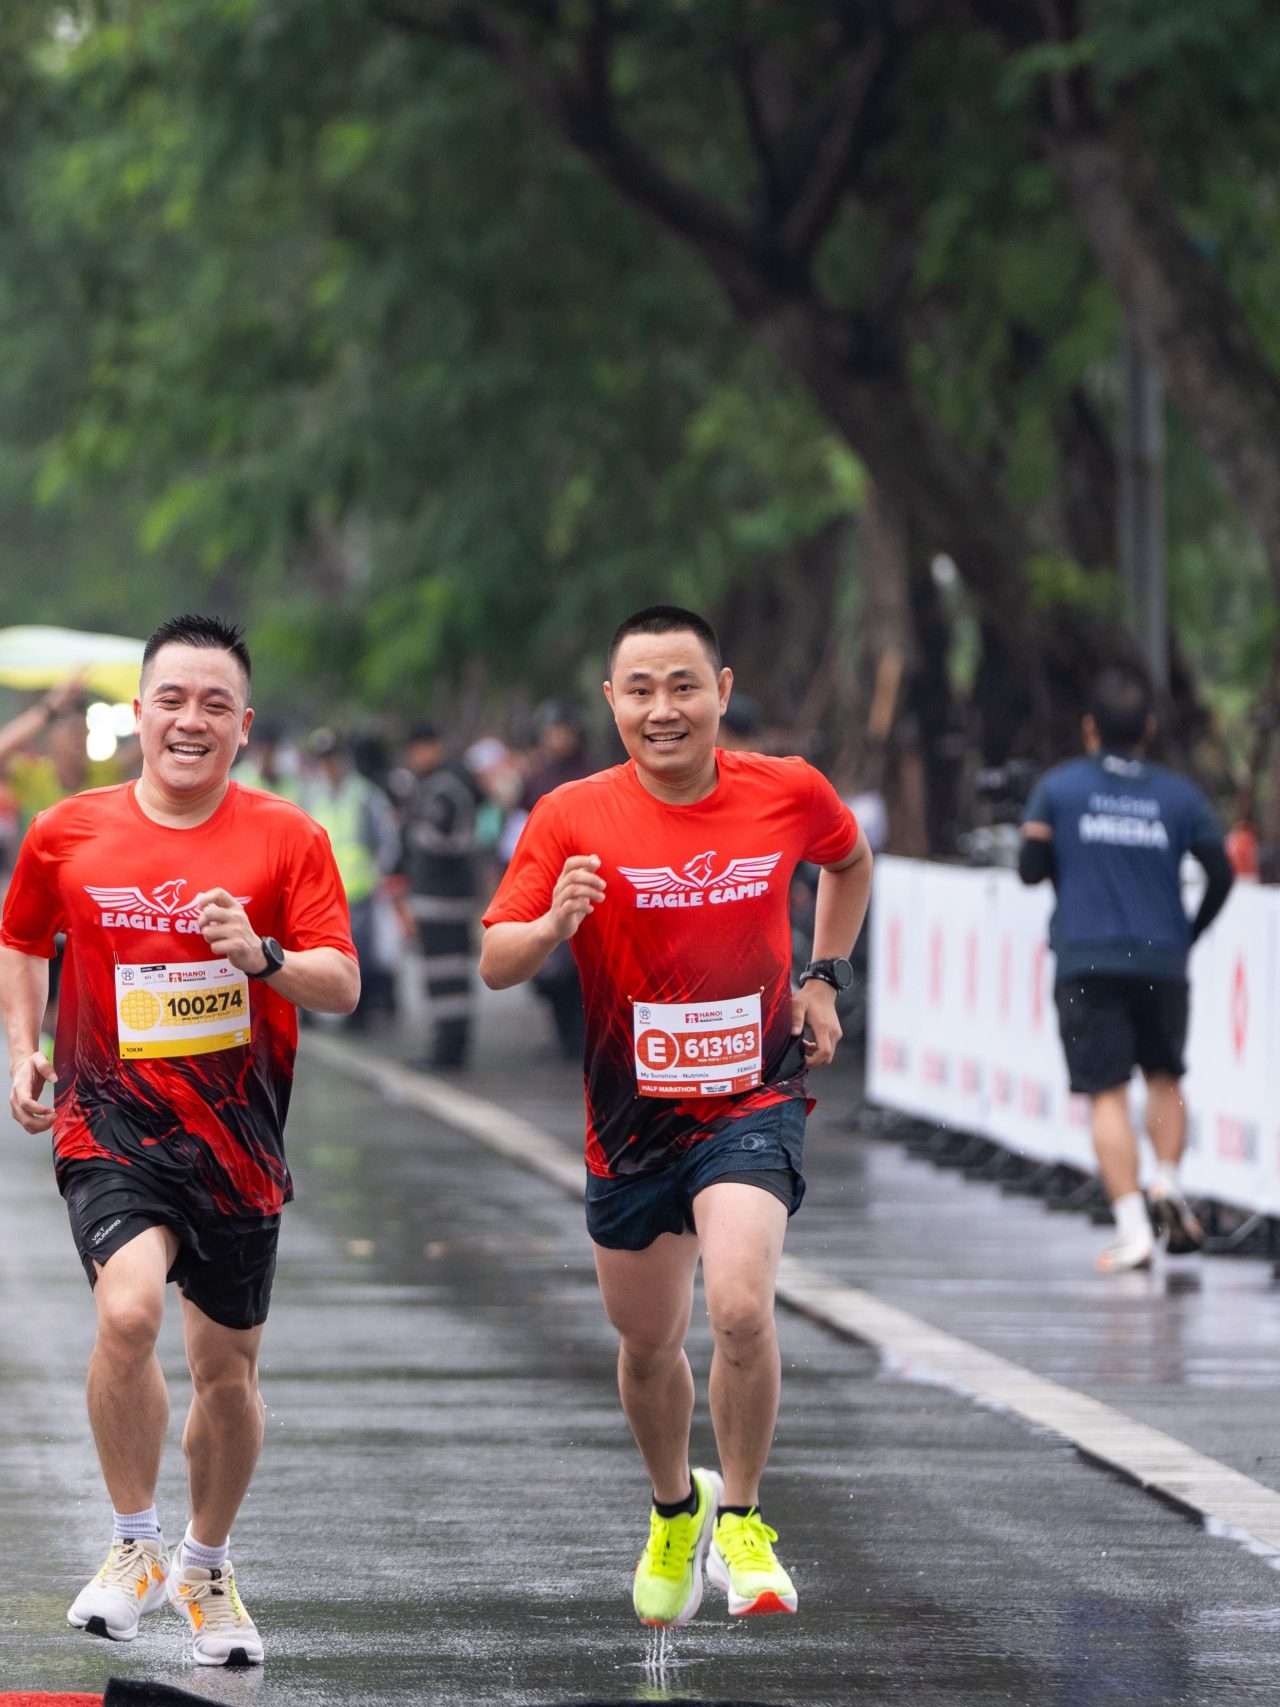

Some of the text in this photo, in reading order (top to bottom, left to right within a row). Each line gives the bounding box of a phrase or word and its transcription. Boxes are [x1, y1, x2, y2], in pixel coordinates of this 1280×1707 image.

[636, 881, 769, 909] EAGLE CAMP
[101, 912, 217, 935] EAGLE CA
[167, 989, 243, 1017] 100274
[699, 1010, 723, 1018] HANOI
[647, 1037, 667, 1063] E
[684, 1030, 755, 1059] 613163
[658, 1085, 697, 1093] MARATHON
